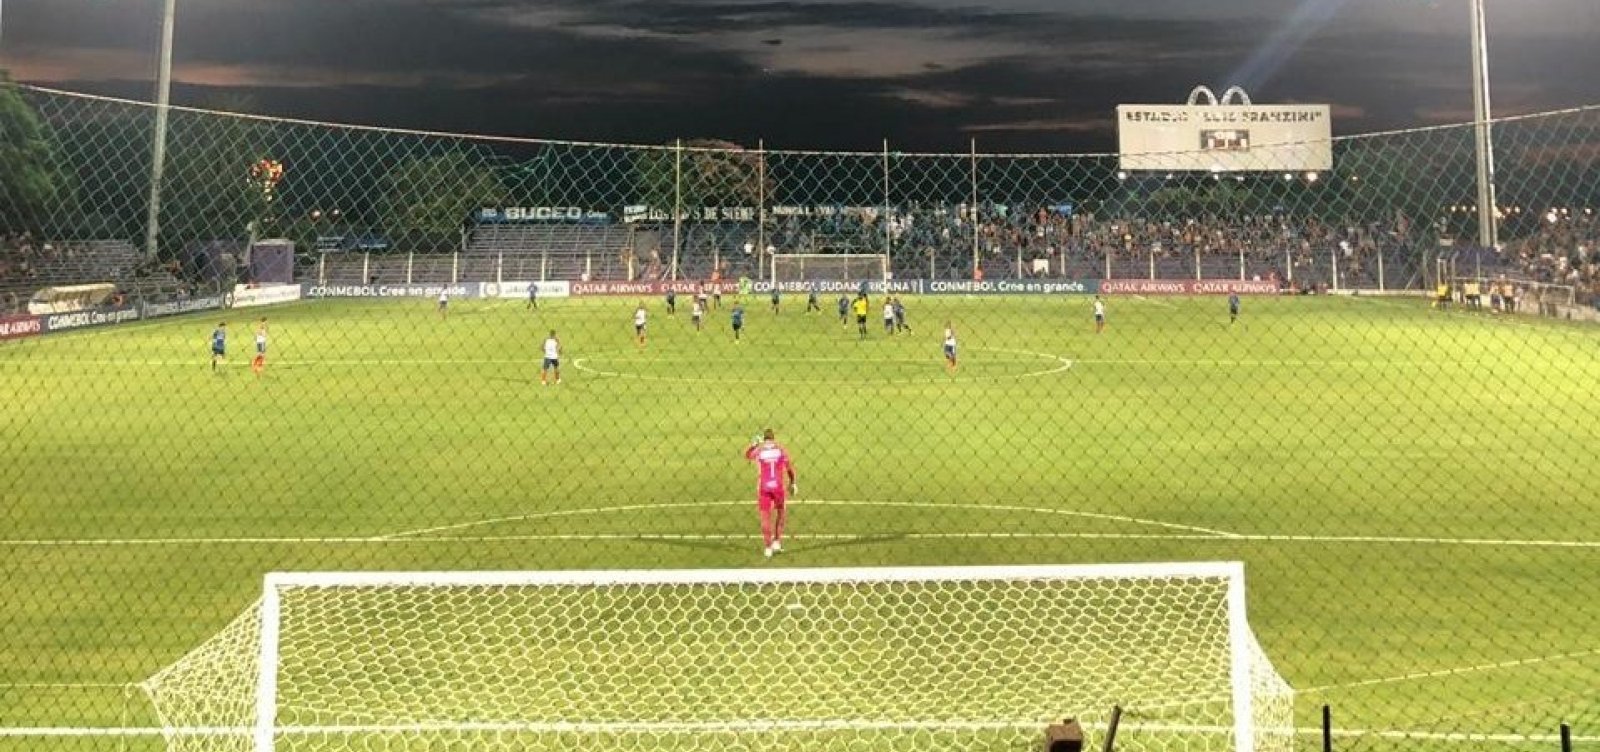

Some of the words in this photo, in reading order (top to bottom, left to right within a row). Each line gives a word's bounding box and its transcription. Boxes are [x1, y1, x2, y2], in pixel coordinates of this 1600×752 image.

[379, 285, 405, 296] Cree
[574, 284, 607, 295] QATAR
[611, 284, 652, 294] AIRWAYS
[1102, 282, 1136, 293] QATAR
[1140, 282, 1185, 292] AIRWAYS
[1193, 282, 1229, 292] QATAR
